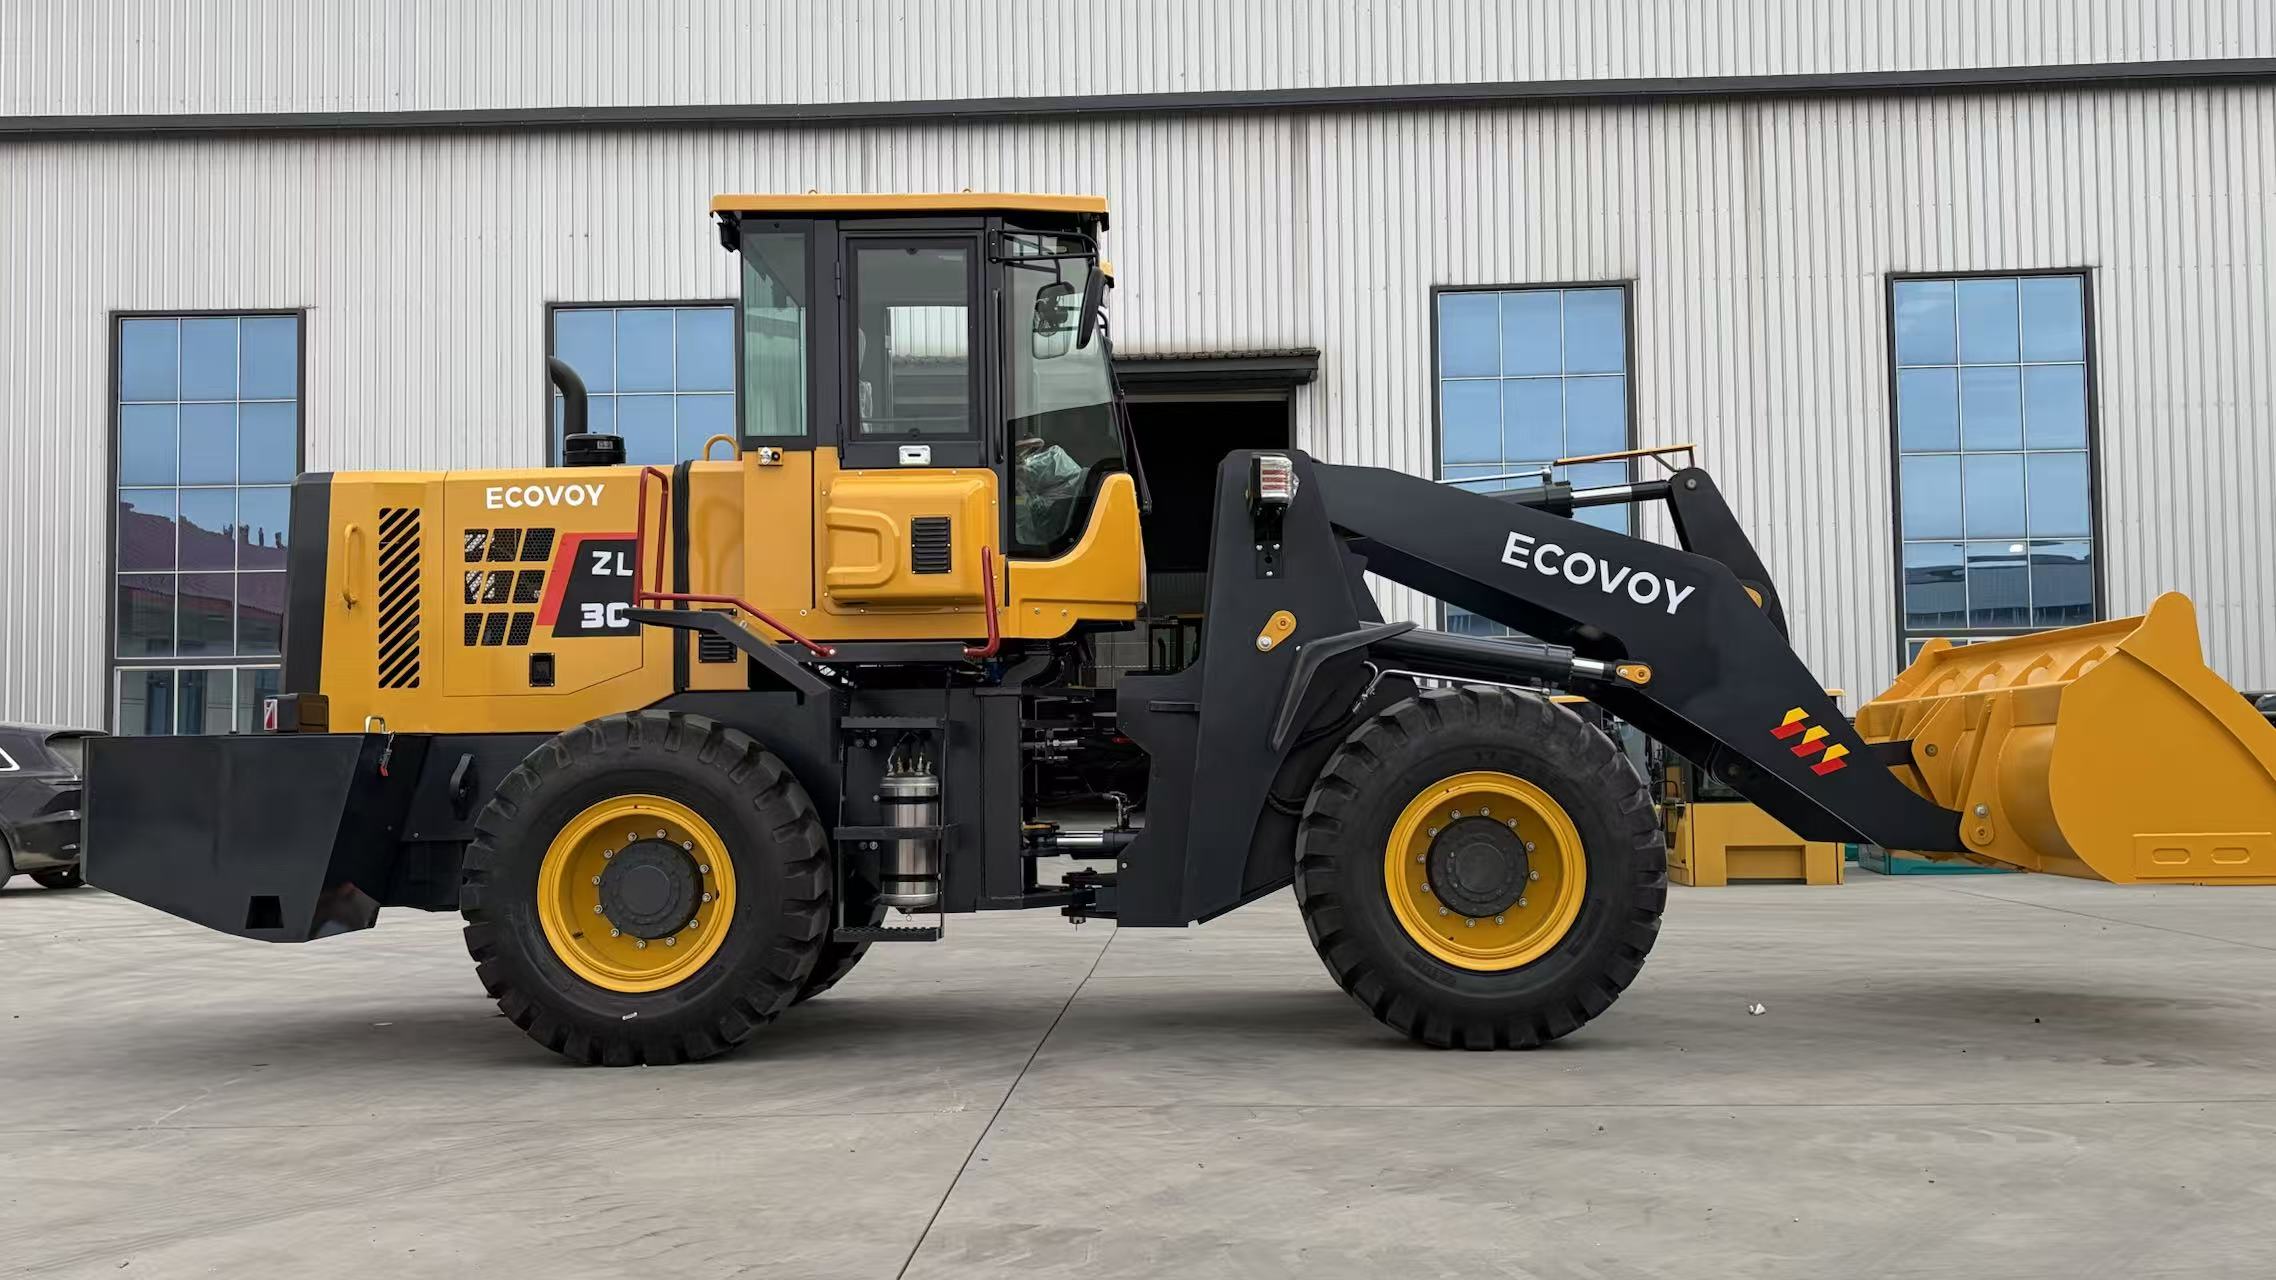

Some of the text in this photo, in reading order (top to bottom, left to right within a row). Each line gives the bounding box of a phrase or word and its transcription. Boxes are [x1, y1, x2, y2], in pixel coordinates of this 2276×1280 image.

[486, 484, 605, 510] ECOVOY
[591, 550, 634, 577] ZL
[1502, 531, 1696, 615] ECOVOY
